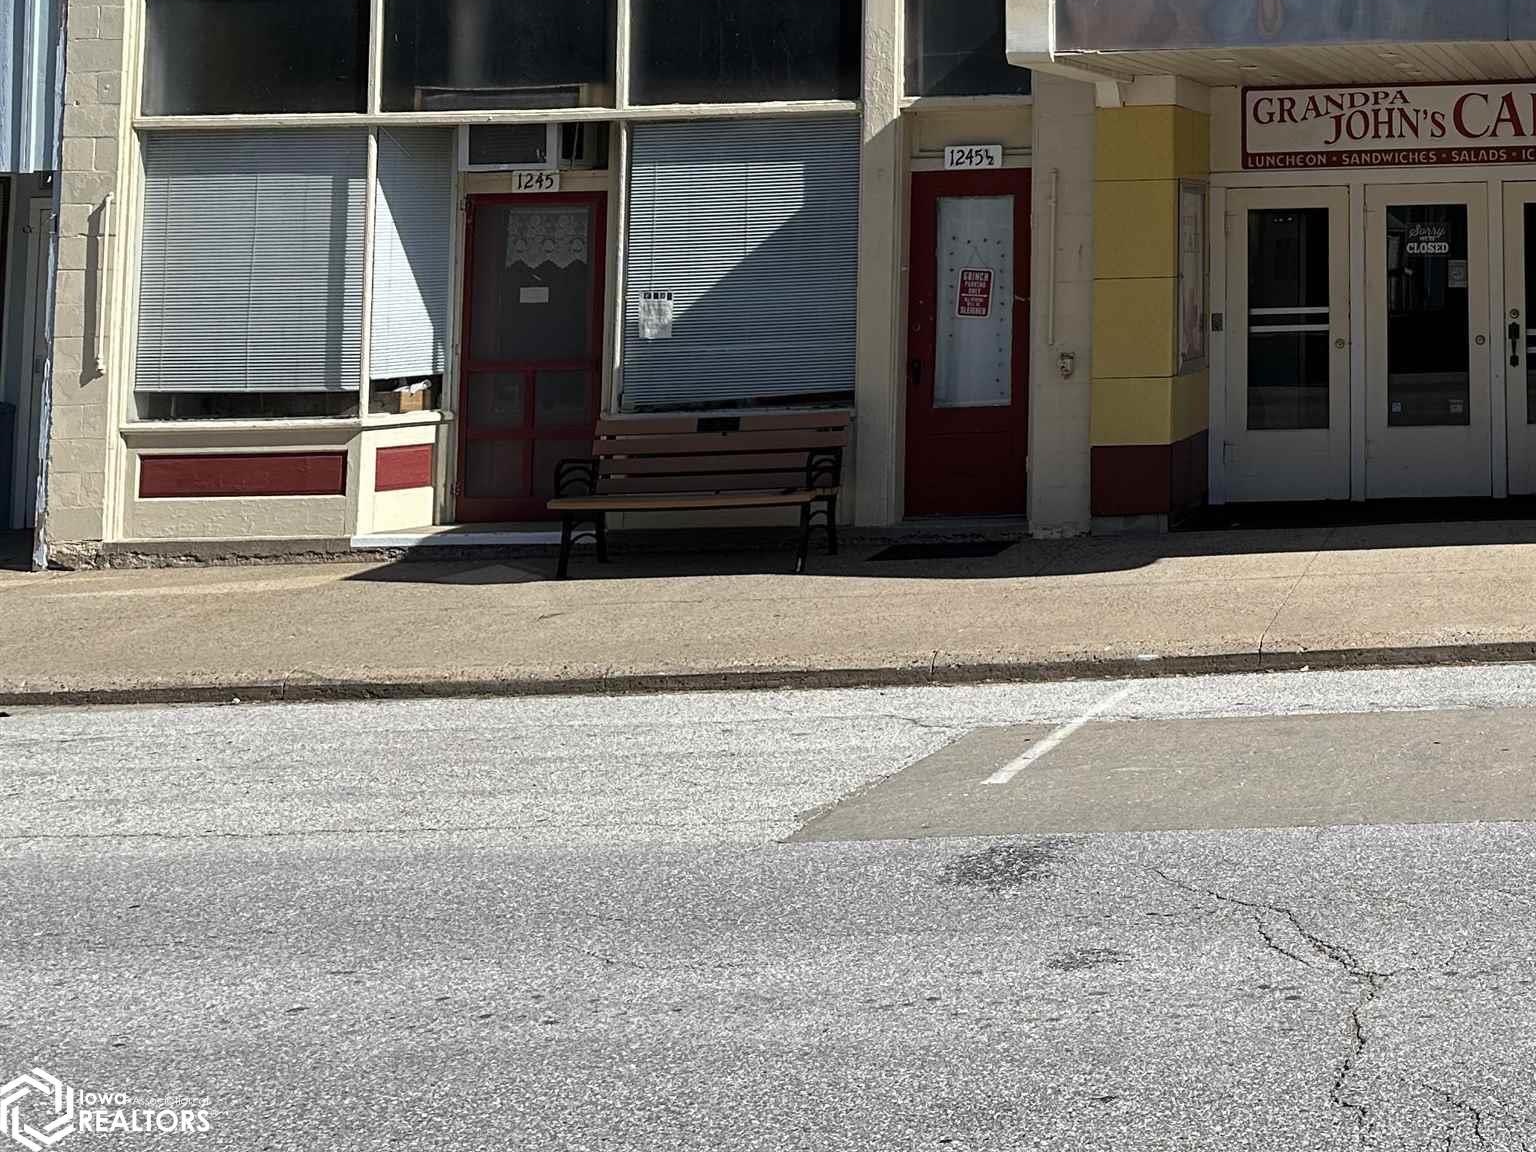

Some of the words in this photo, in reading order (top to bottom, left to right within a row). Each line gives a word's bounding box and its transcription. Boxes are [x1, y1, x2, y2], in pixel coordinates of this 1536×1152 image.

[1252, 89, 1410, 125] GRANDPA
[1323, 107, 1447, 145] JOHN'S
[1247, 151, 1328, 168] LUNCHEON
[1340, 149, 1438, 165] SANDWICHES
[1451, 148, 1509, 163] SALADS
[518, 172, 554, 190] 1245
[1406, 242, 1449, 254] CLOSED
